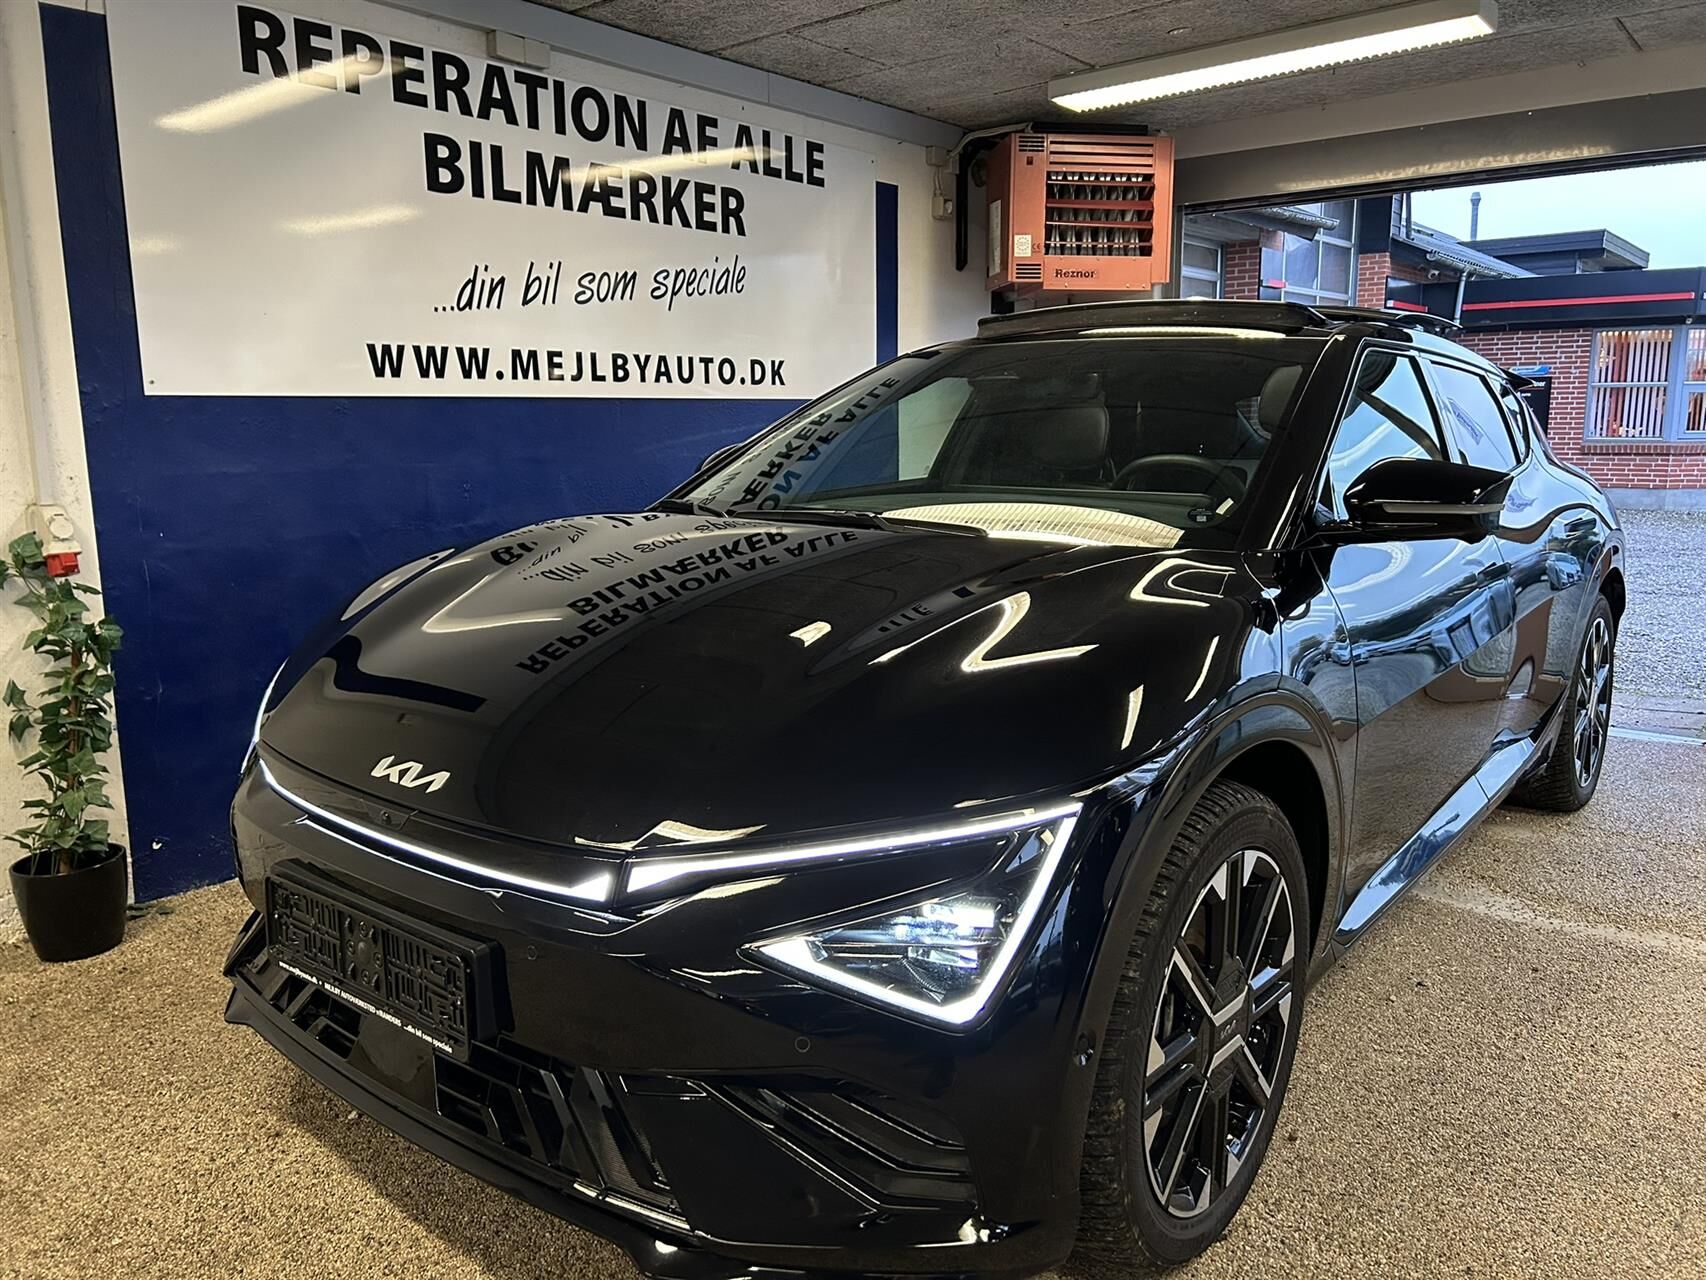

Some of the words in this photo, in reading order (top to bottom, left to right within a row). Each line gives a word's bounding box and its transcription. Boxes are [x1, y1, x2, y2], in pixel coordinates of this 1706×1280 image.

[237, 5, 647, 151] REPERATION
[663, 106, 720, 159] AF
[731, 123, 826, 189] ALLE
[423, 133, 747, 237] BILMÆRKER
[523, 257, 560, 305] bil
[575, 269, 637, 307] som
[650, 254, 746, 312] speciale
[1055, 268, 1096, 279] Reznor
[366, 343, 786, 387] WWW.MEJLBYAUTO.DK
[370, 755, 451, 794] KIA
